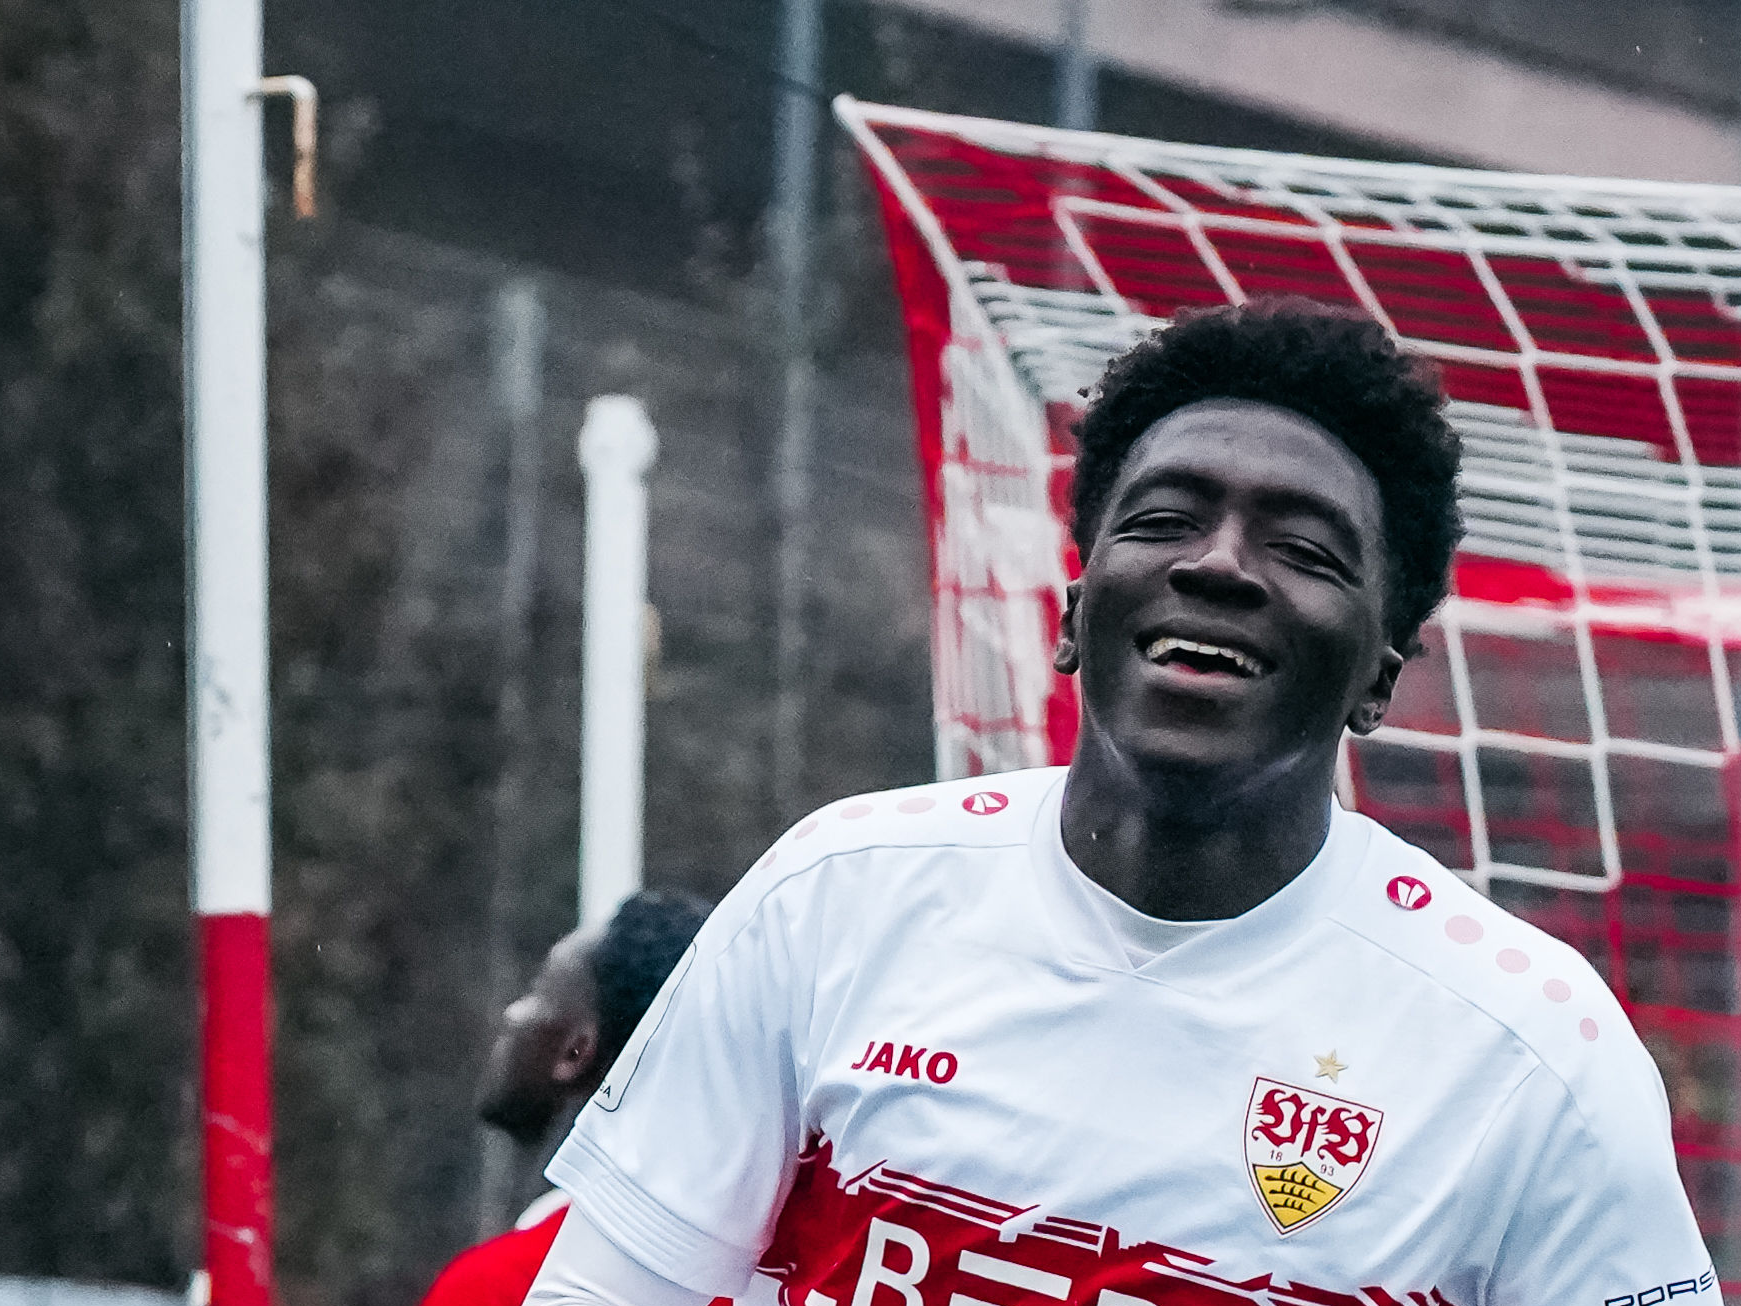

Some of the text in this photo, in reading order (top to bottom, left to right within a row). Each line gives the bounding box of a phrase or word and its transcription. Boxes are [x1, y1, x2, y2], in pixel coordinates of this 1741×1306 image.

[850, 1041, 958, 1084] JAKO
[1251, 1089, 1376, 1167] VfB
[1269, 1149, 1335, 1177] 18 93
